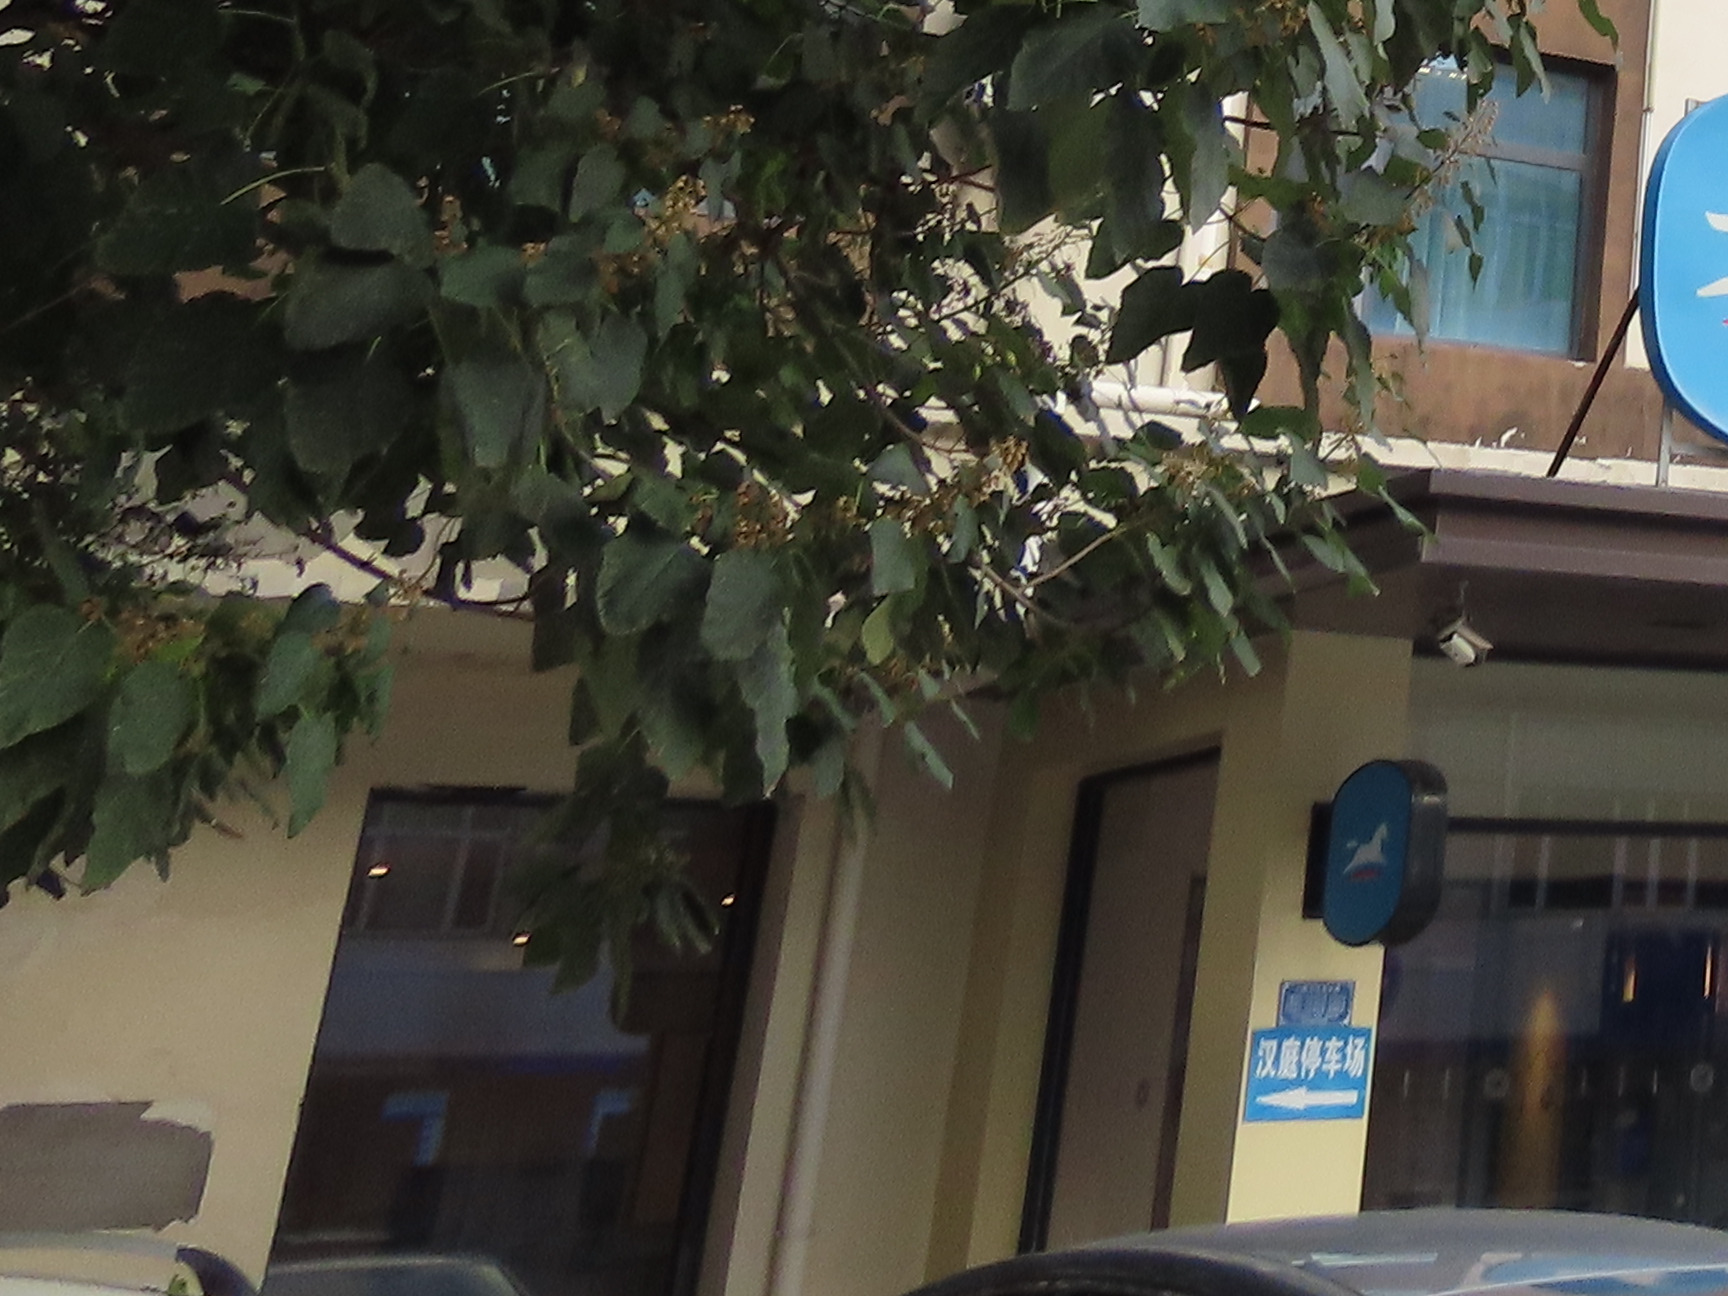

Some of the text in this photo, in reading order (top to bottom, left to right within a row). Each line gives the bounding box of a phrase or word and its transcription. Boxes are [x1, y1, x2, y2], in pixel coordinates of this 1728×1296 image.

[1255, 1034, 1367, 1080] 汉庭停车场
